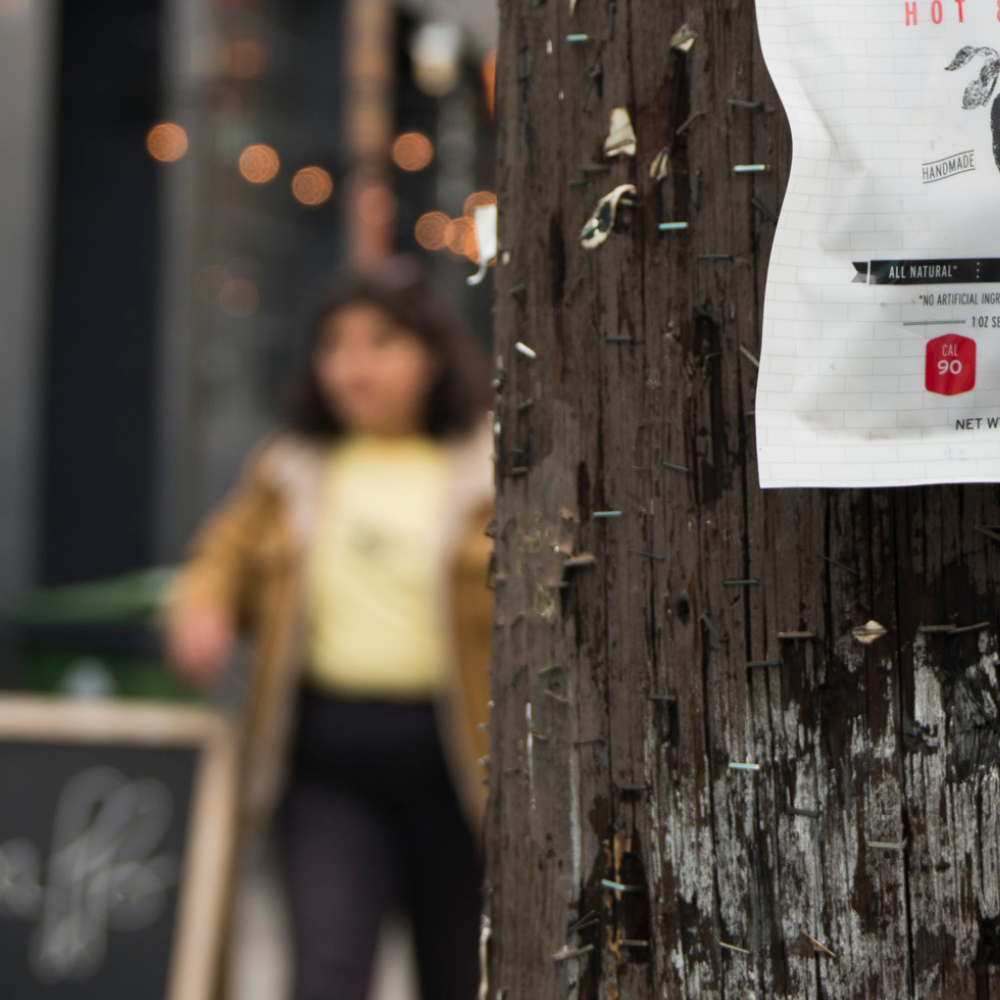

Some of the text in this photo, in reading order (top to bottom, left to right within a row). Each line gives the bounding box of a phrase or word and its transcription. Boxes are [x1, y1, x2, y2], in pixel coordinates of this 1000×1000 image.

[922, 154, 975, 180] HANDMADE
[889, 265, 905, 278] ALL
[937, 293, 978, 305] ARTIFICIAL
[978, 316, 988, 328] OZ
[942, 343, 959, 357] CAL
[937, 360, 962, 375] 90
[956, 418, 983, 431] NET
